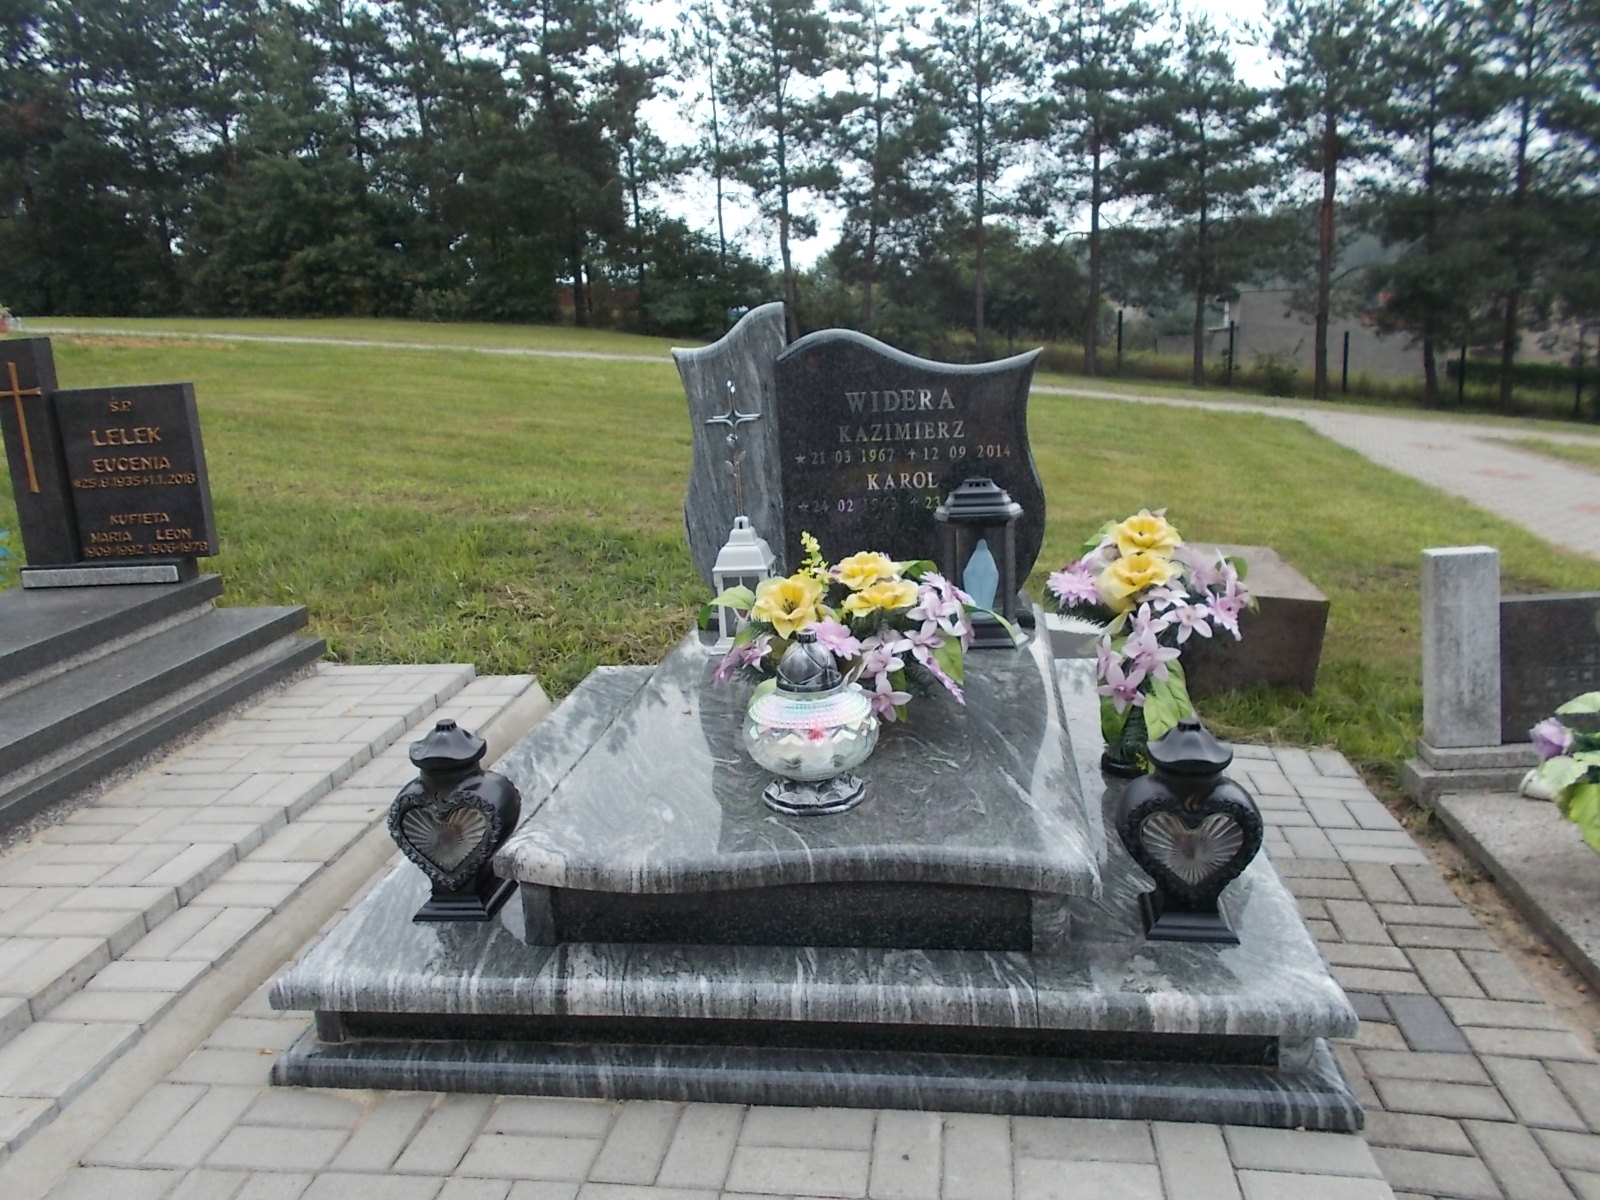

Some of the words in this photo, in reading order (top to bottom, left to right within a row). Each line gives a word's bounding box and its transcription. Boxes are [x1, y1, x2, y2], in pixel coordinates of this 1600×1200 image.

[845, 388, 955, 413] WIDERA
[90, 427, 162, 446] LELEK
[838, 420, 965, 443] KAZIMIERZ
[811, 451, 826, 464] 21
[835, 450, 851, 463] 03
[861, 449, 894, 463] 1967
[923, 447, 939, 460] 12
[949, 446, 967, 459] 09
[977, 445, 1011, 458] 2014
[92, 456, 172, 473] EUGENIA
[866, 471, 938, 490] KAROL
[837, 499, 854, 512] 02
[110, 512, 171, 525] KUFIETA
[90, 531, 132, 543] MARIA
[156, 528, 192, 541] LEON
